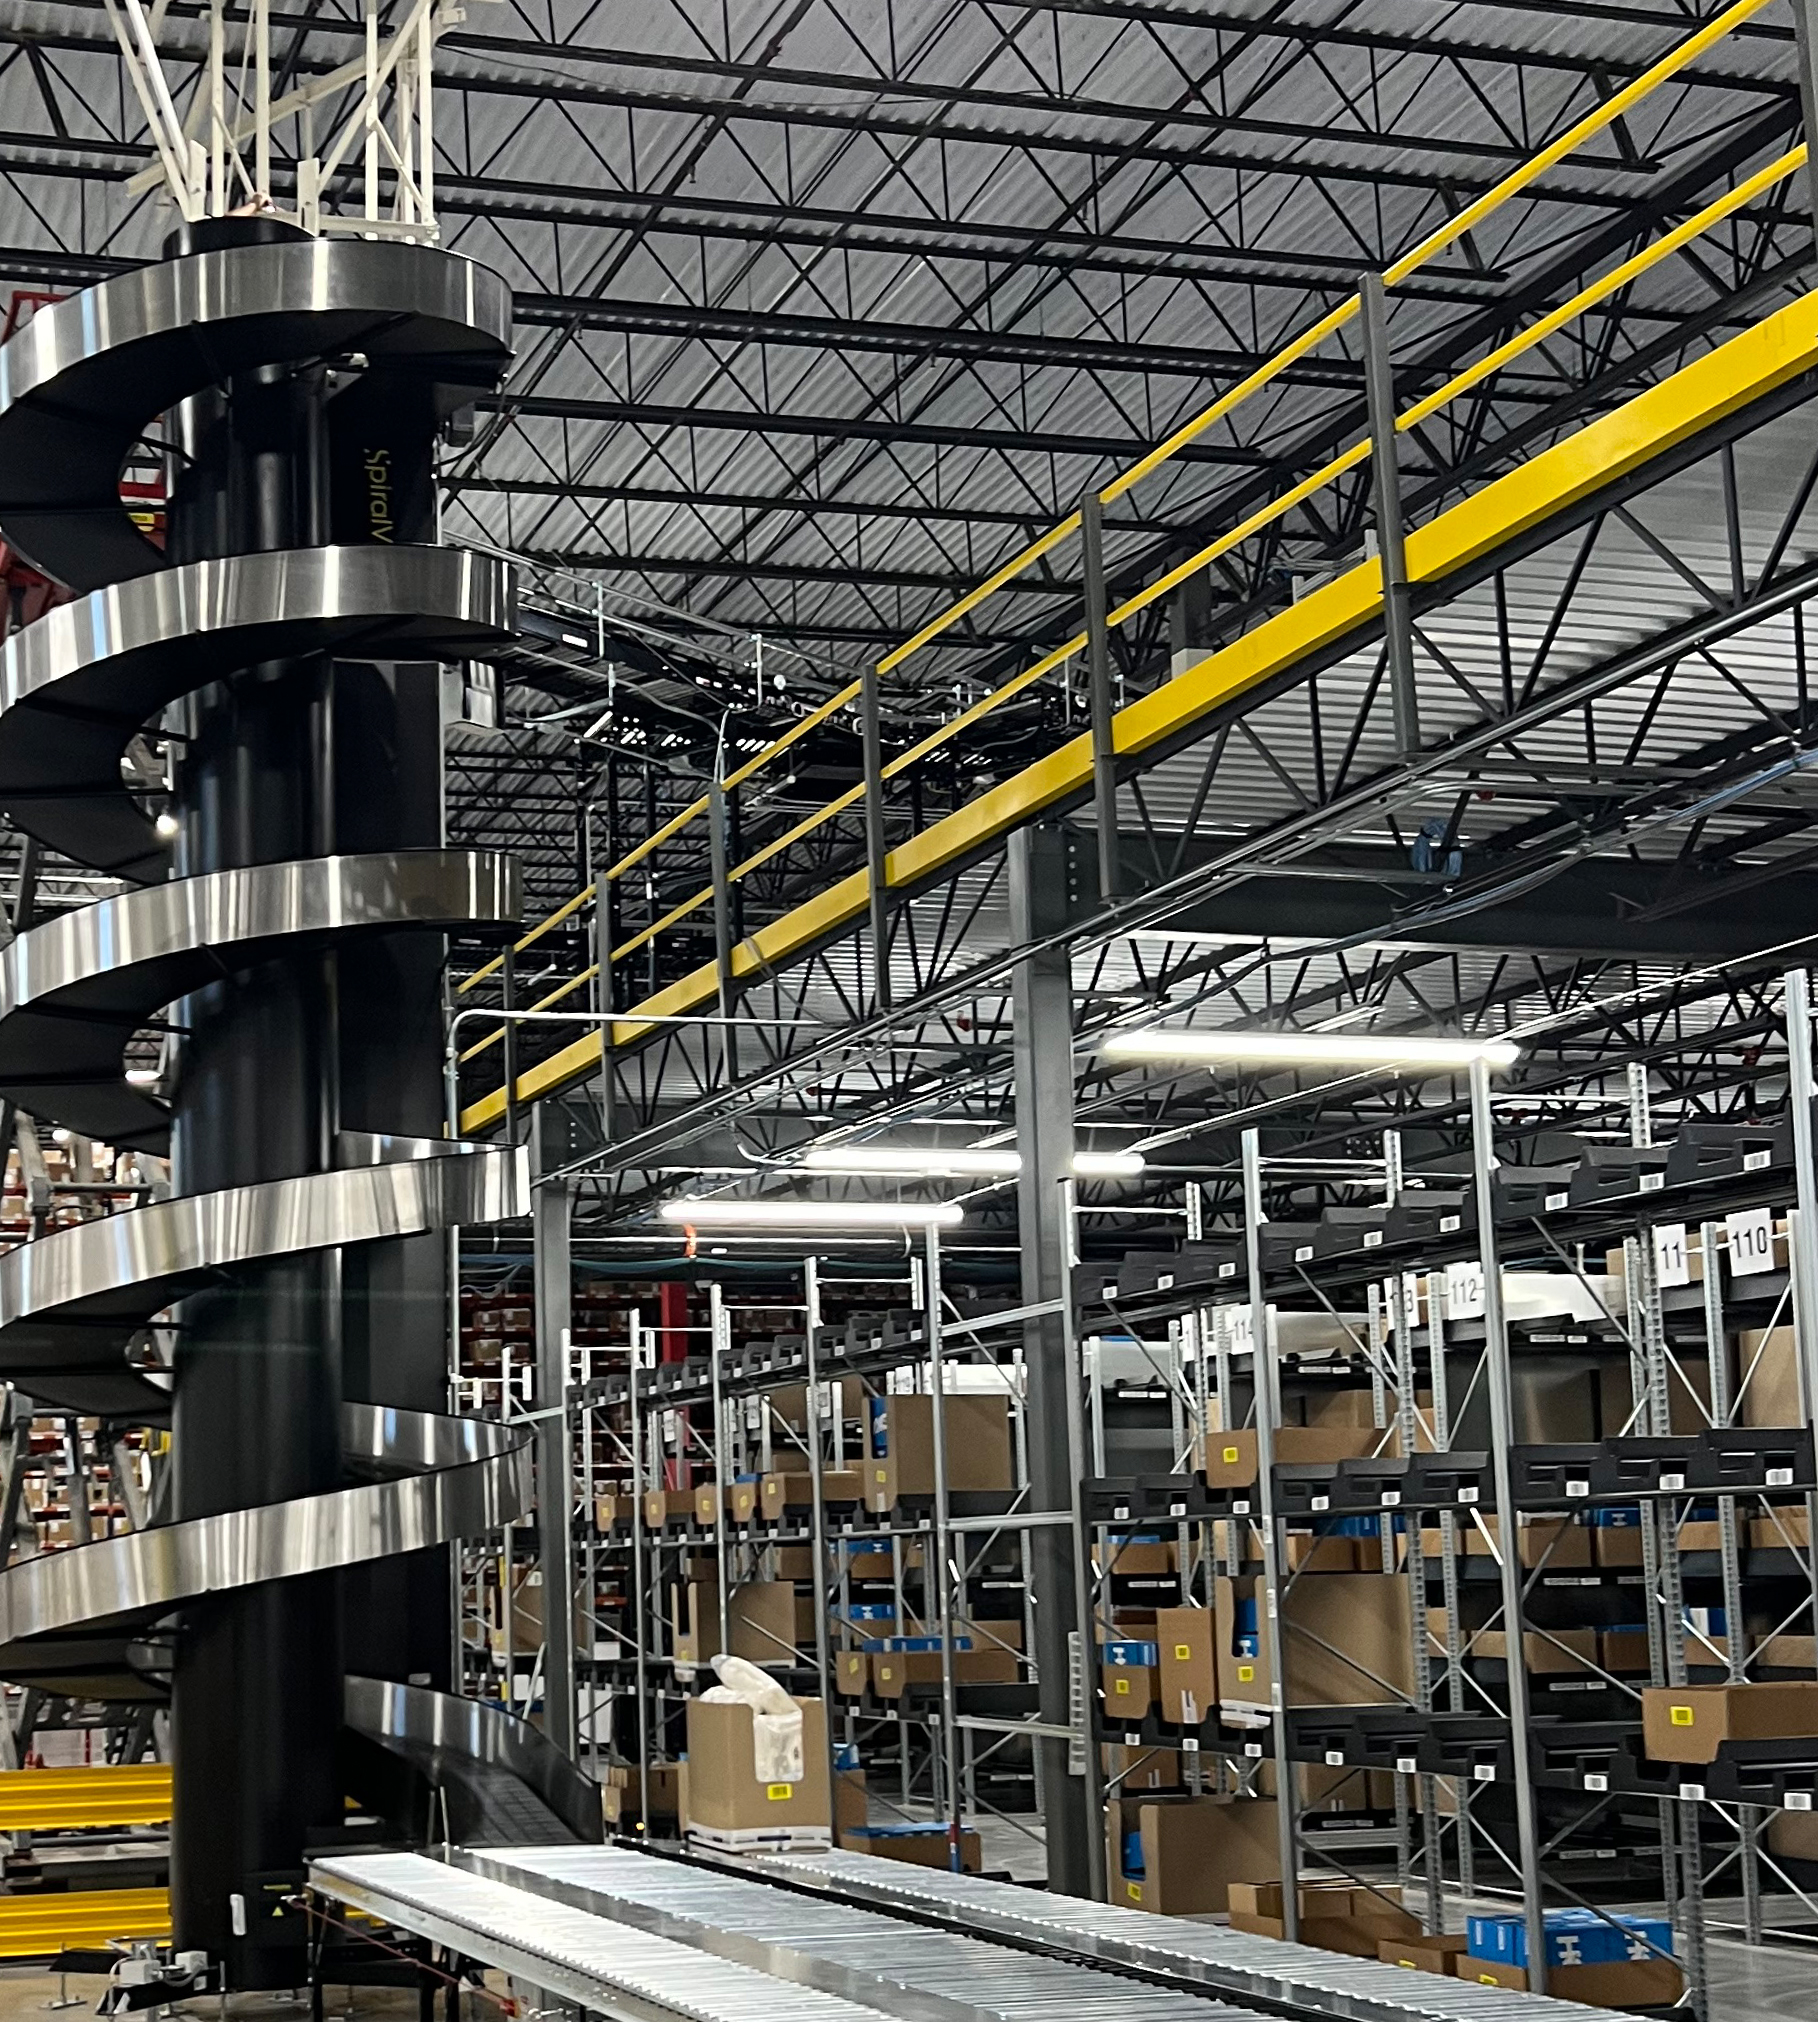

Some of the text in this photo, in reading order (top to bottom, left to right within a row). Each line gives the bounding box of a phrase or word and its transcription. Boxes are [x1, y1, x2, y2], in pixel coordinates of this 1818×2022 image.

[1660, 1241, 1681, 1270] 11
[1732, 1226, 1767, 1258] 110
[1452, 1278, 1477, 1304] 112
[1234, 1319, 1253, 1341] 11
